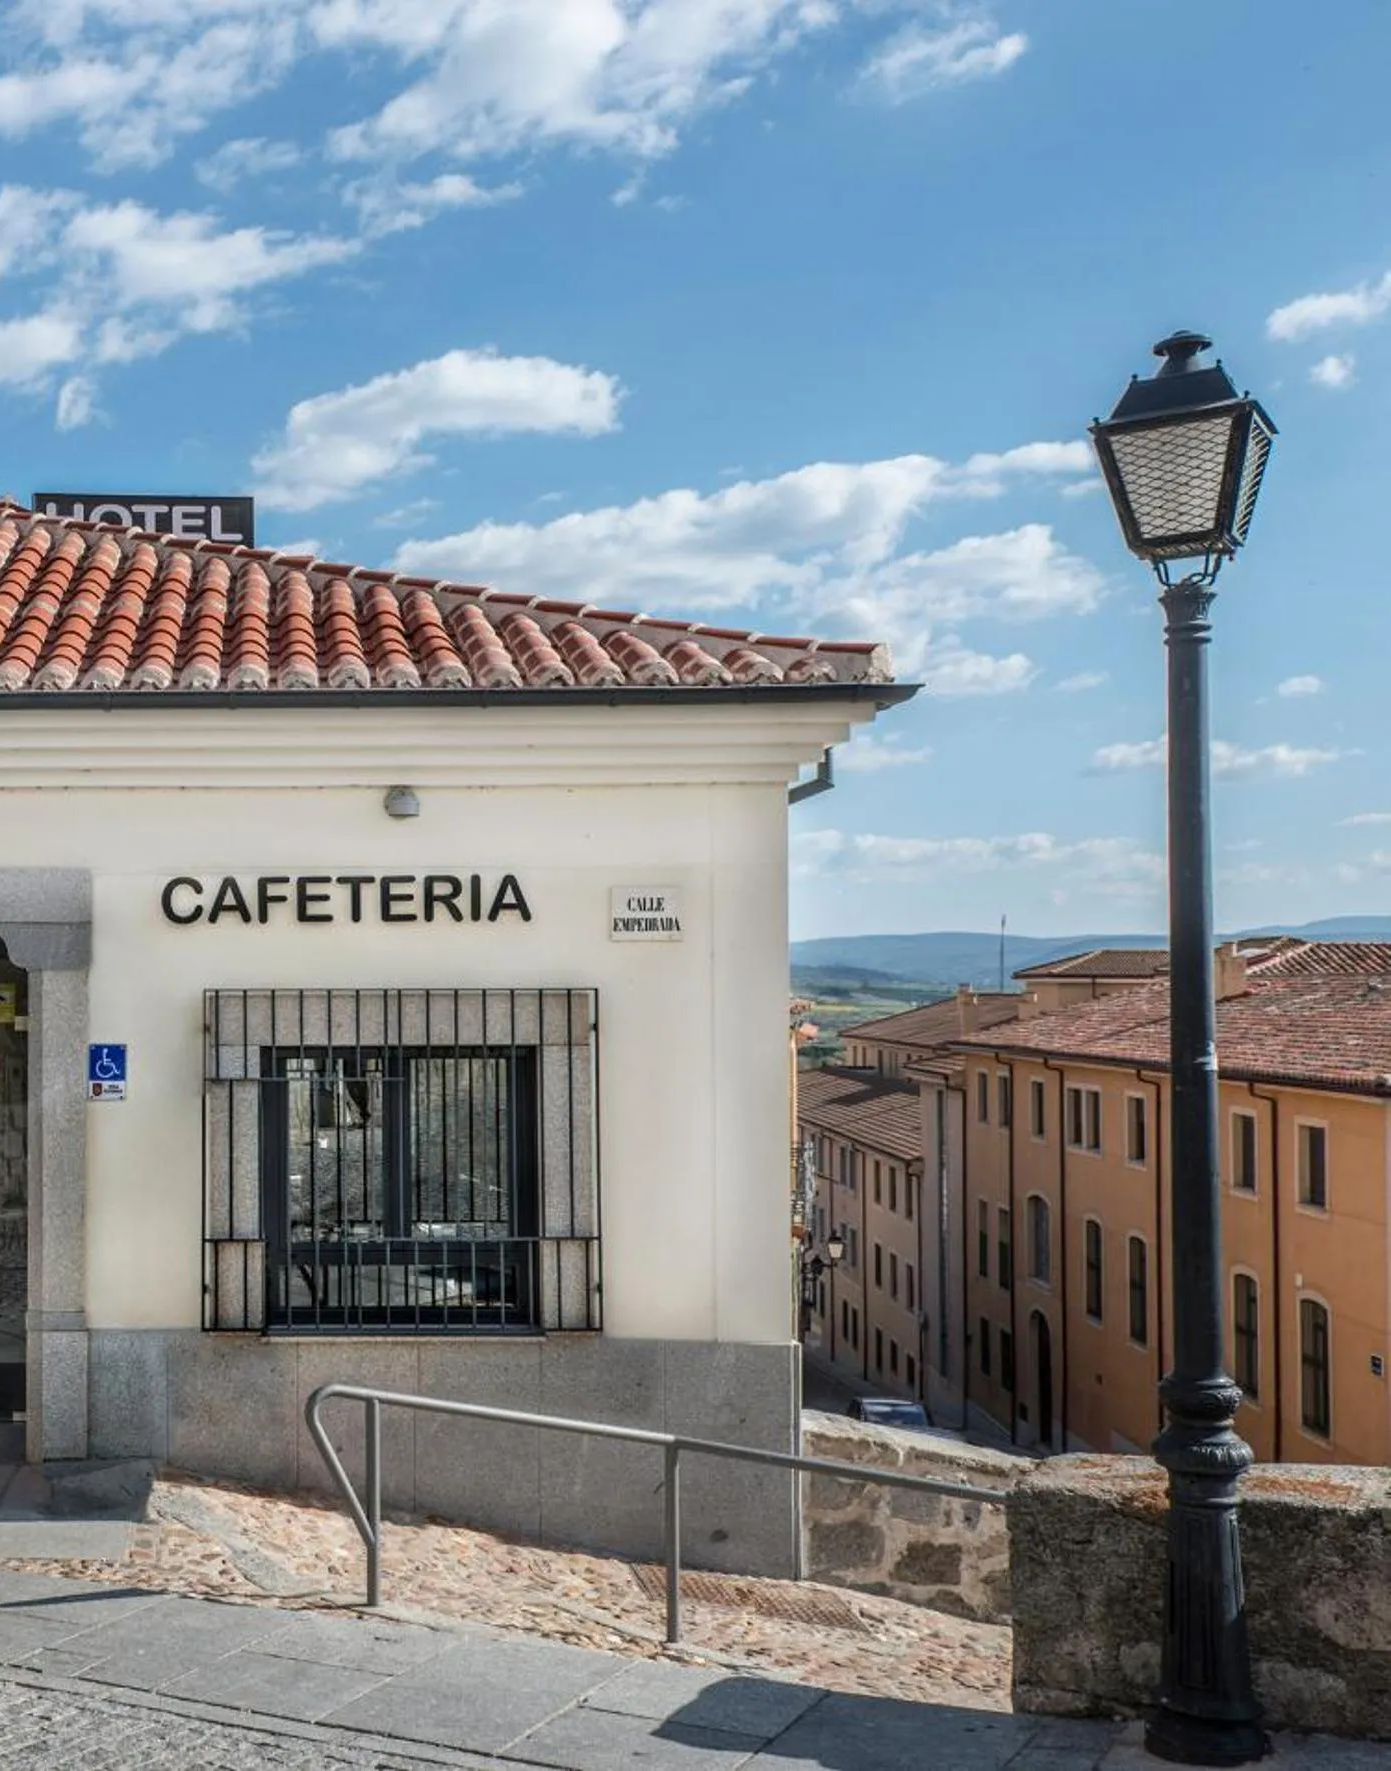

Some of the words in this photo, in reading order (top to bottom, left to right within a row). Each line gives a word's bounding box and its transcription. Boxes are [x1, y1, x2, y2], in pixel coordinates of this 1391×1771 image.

[46, 502, 243, 541] HOTEL
[161, 873, 532, 924] CAFETERIA
[627, 896, 665, 912] CALLE
[612, 916, 681, 932] EMPEDRADA
